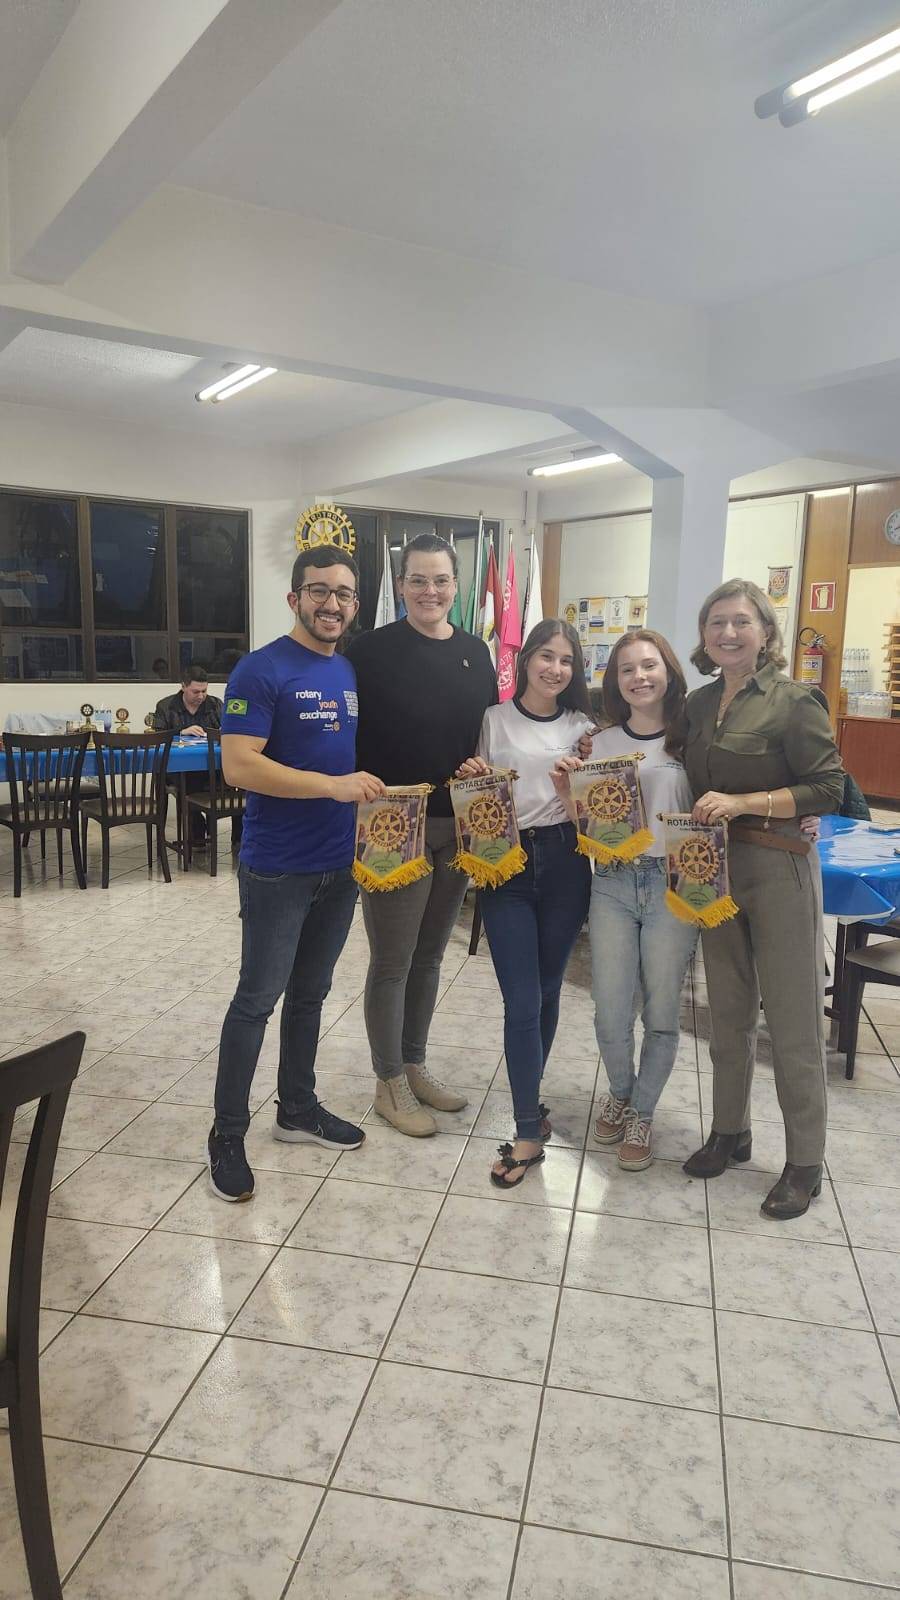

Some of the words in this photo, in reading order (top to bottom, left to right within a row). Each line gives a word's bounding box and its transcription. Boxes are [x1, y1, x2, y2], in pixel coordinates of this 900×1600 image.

[310, 511, 342, 525] ROTARY
[296, 690, 321, 700] rotary
[319, 700, 338, 710] youth
[300, 710, 337, 720] exchange
[573, 761, 608, 773] ROTARY
[610, 760, 633, 769] CLUB
[454, 776, 484, 791] ROTARY
[667, 819, 698, 827] ROTARY
